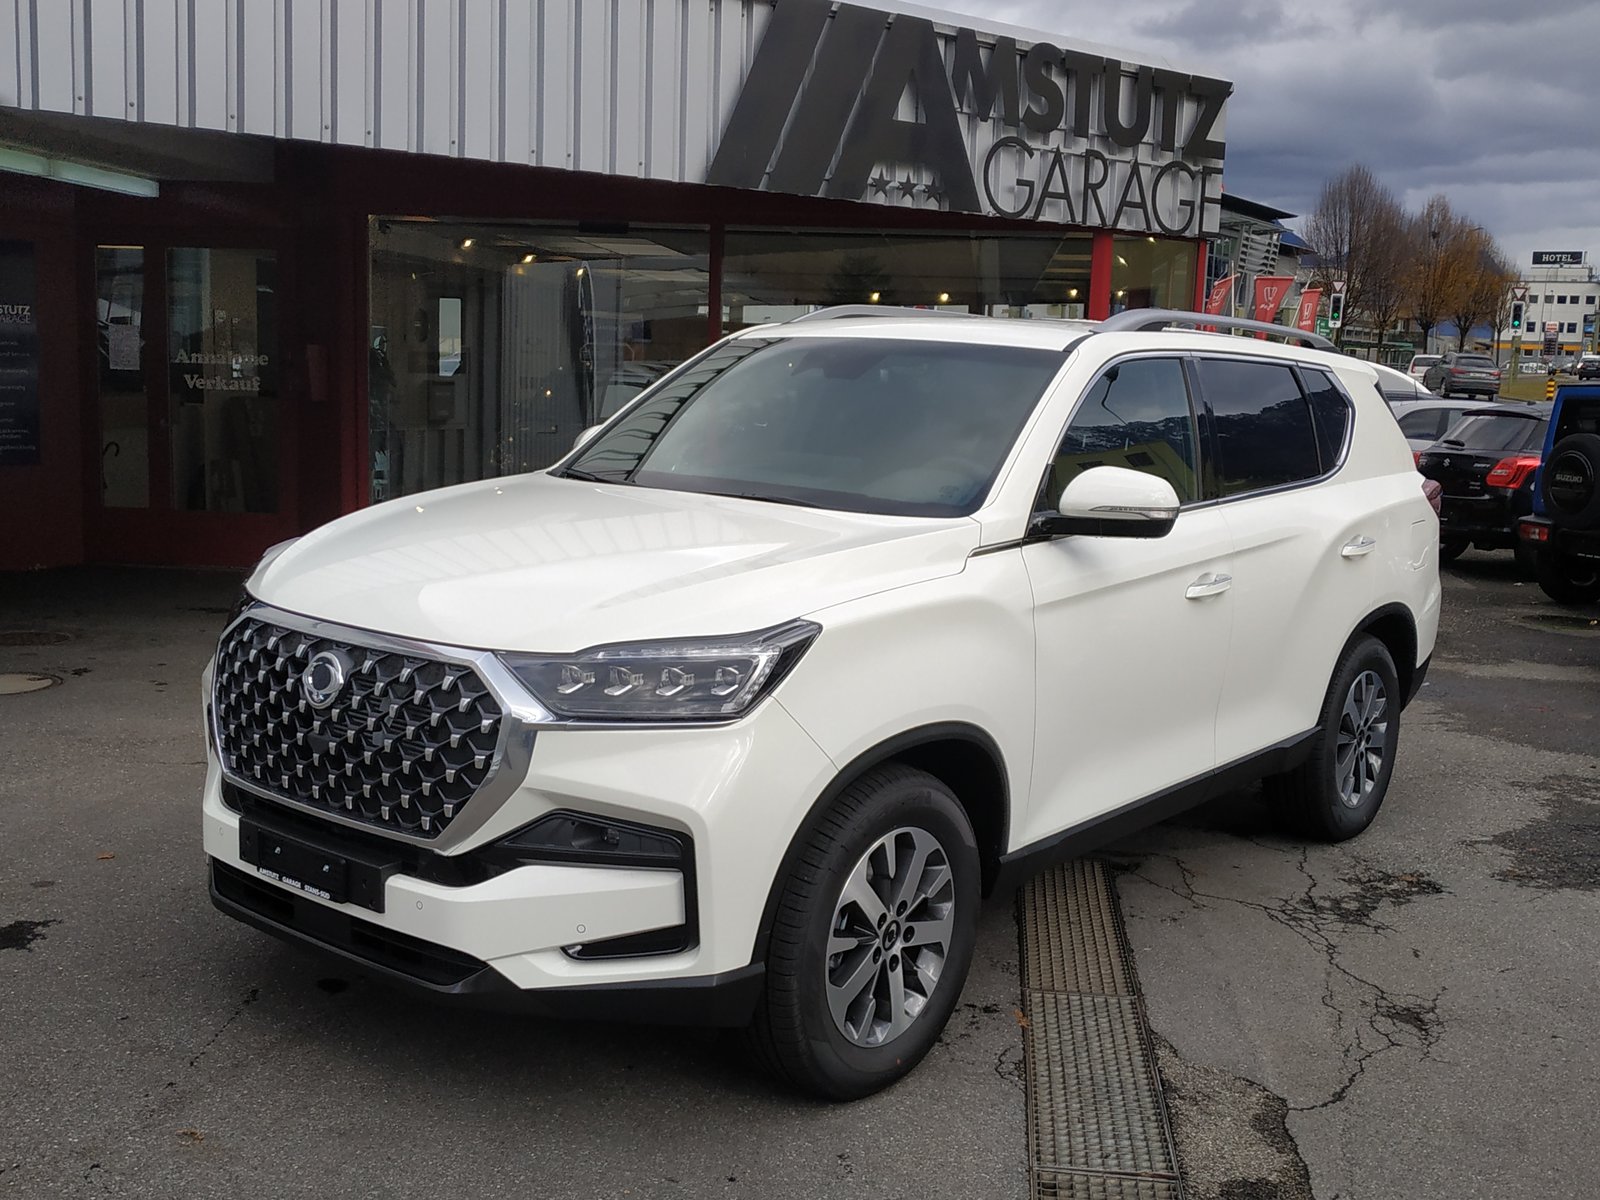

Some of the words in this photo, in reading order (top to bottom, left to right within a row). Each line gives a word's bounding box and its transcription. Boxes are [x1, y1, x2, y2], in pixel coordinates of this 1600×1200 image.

[823, 13, 1233, 213] AMSTUTZ
[983, 136, 1222, 237] GARAGE
[1542, 254, 1573, 263] HOTEL
[183, 374, 261, 392] Verkauf
[1555, 473, 1583, 484] SUZUKI
[282, 876, 301, 888] GARAGE
